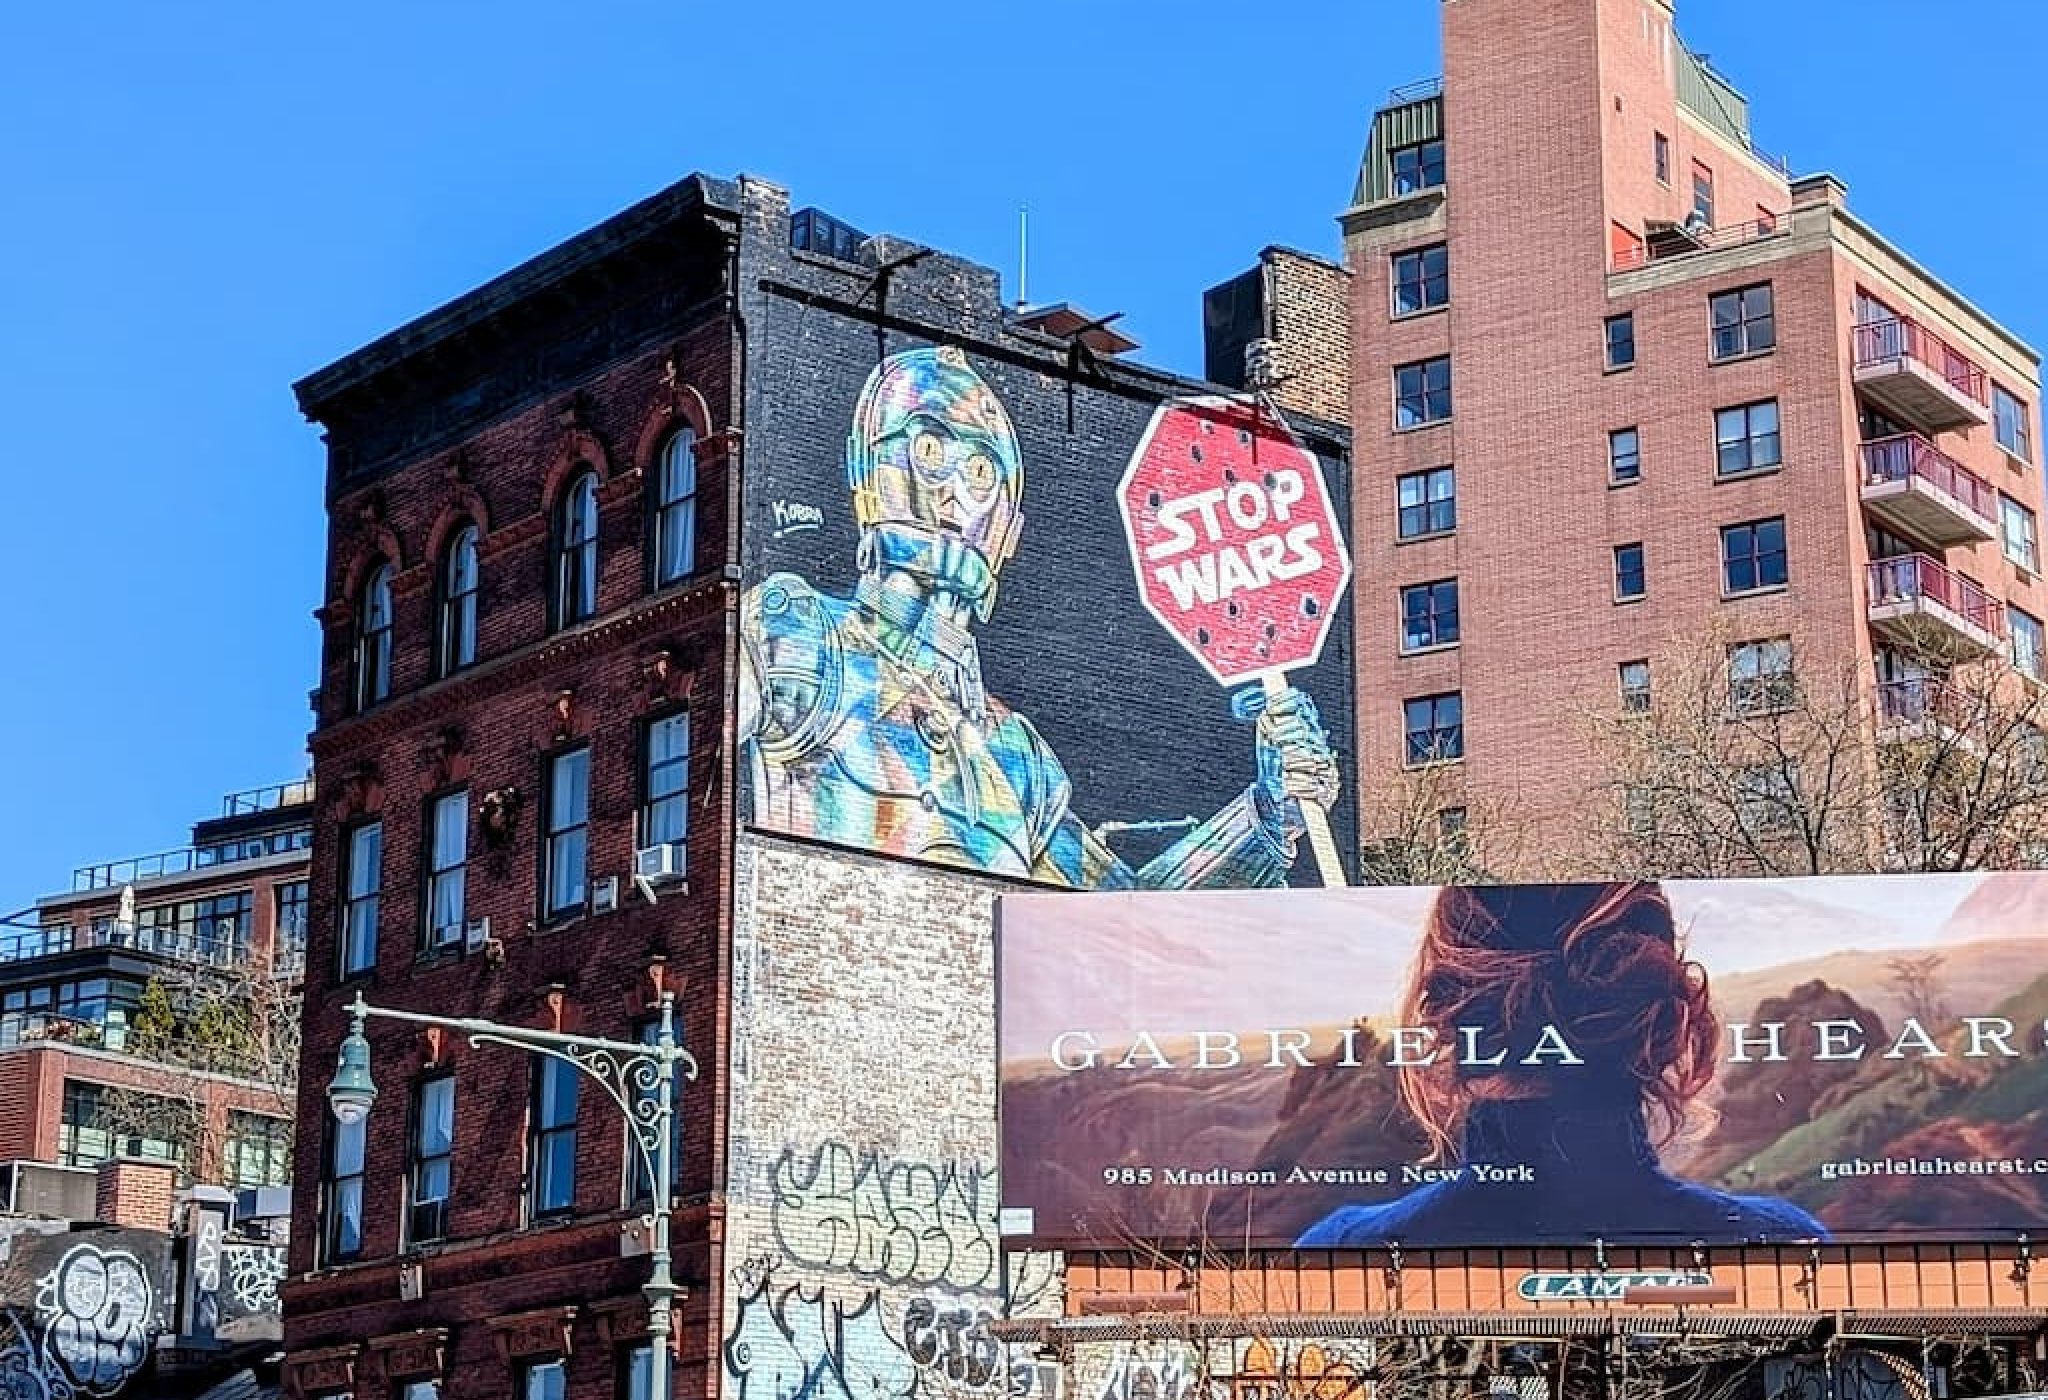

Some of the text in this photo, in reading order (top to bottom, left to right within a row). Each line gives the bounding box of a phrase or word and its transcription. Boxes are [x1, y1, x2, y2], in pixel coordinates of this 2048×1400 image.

[1147, 469, 1304, 560] STOP
[1154, 521, 1323, 611] WARS
[1050, 1016, 2048, 1072] GABRIELA HEAR
[1103, 1164, 1535, 1185] 985 Madison Avenue New York
